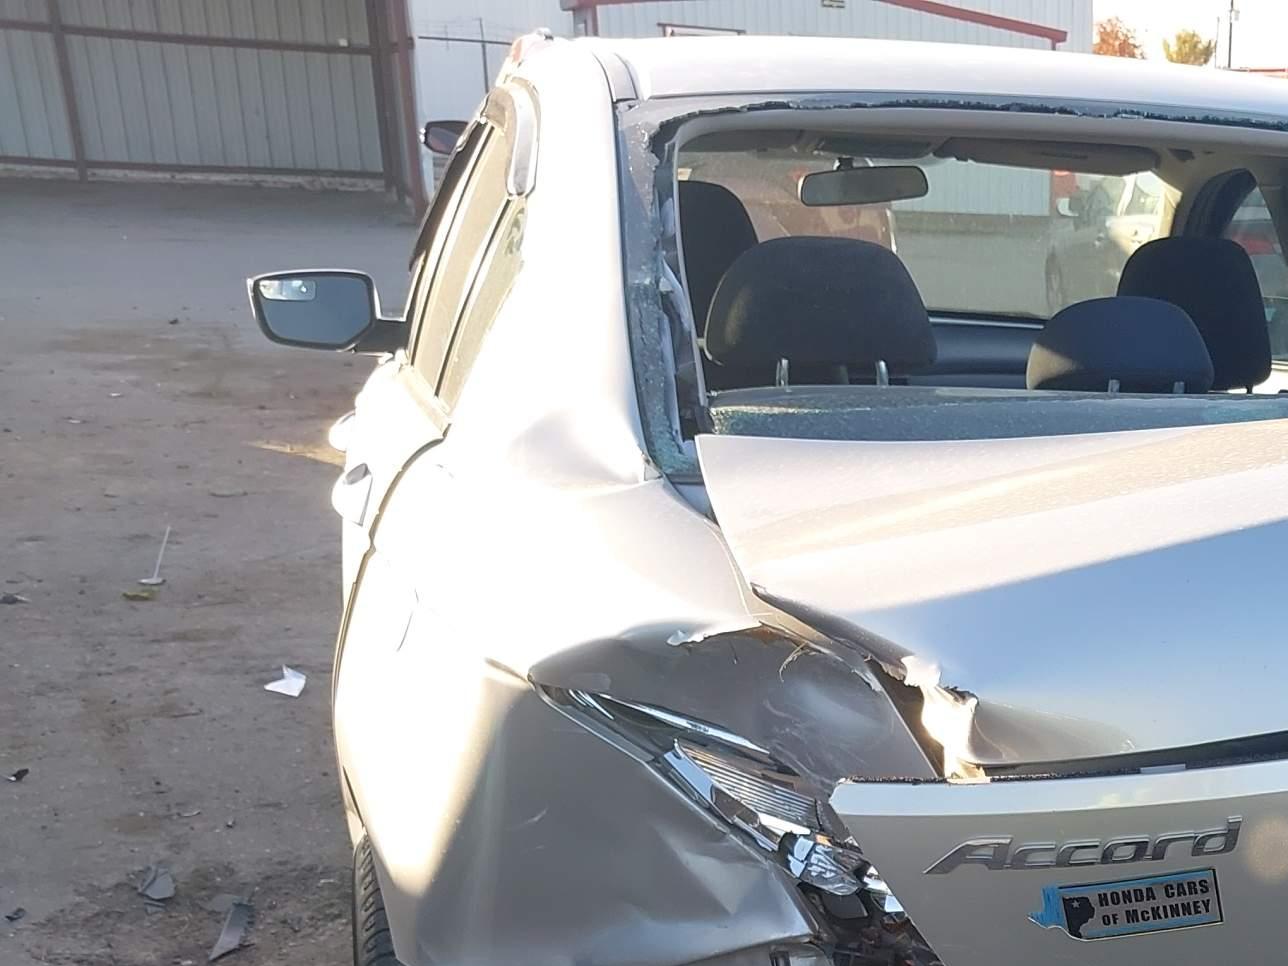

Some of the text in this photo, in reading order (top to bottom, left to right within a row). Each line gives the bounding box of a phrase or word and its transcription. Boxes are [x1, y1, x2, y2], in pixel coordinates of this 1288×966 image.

[922, 815, 1243, 875] Accord
[1098, 879, 1210, 907] HONDA CARS
[1102, 898, 1211, 926] OF McKINNEY
